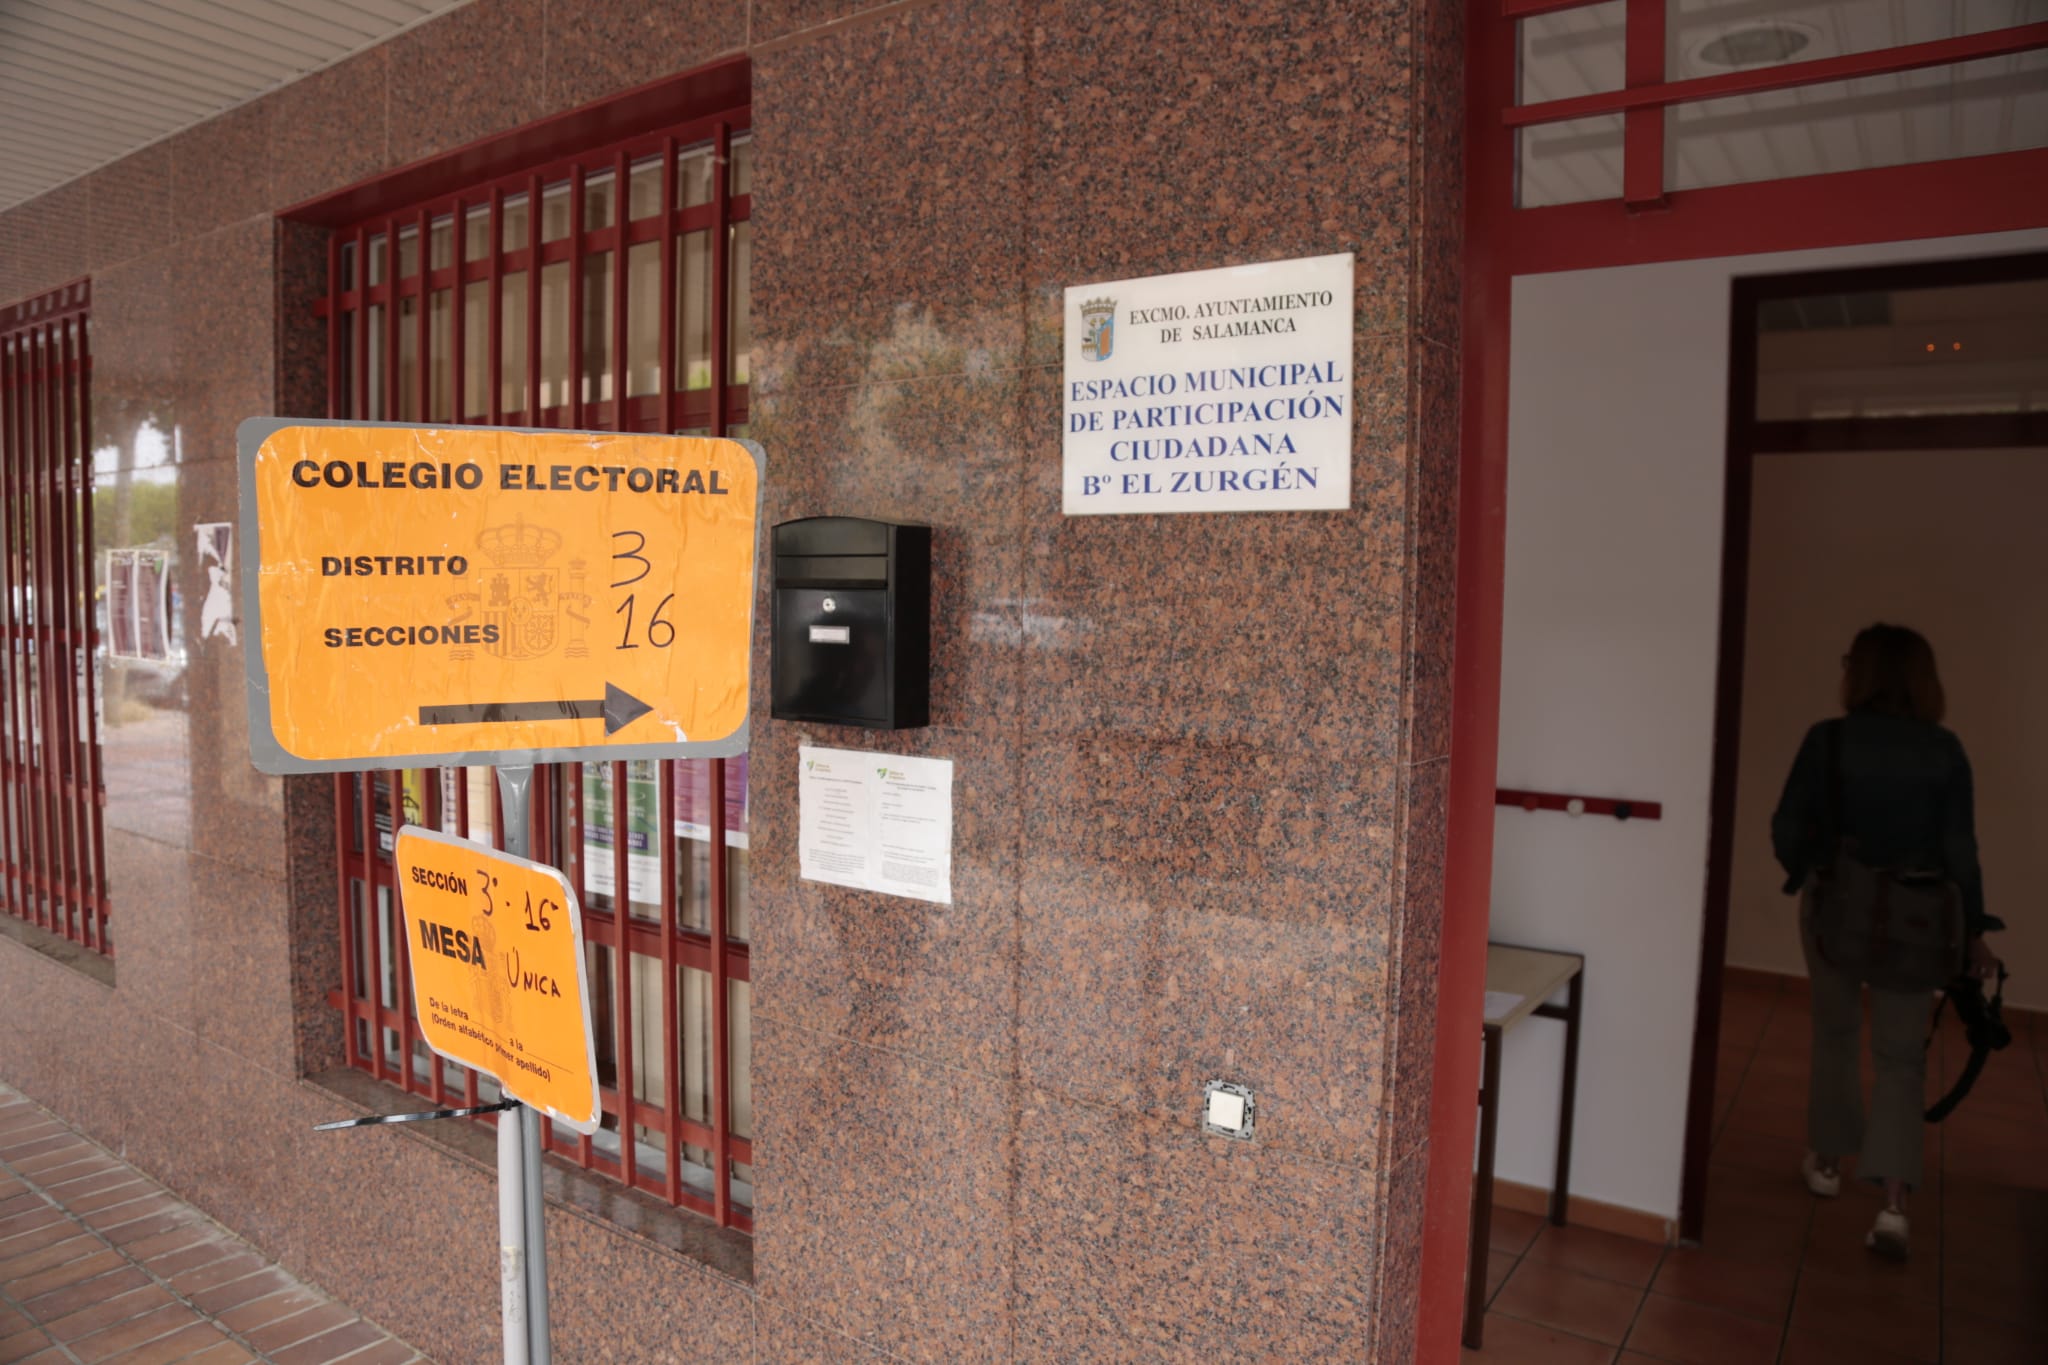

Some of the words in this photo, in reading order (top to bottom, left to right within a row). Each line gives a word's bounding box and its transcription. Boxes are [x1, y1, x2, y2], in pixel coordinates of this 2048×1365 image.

[1129, 304, 1190, 325] EXCMO.
[1194, 290, 1333, 319] AYUNTAMIENTO
[1160, 328, 1182, 344] DE
[1192, 317, 1297, 341] SALAMANCA
[1071, 373, 1177, 402] ESPACIO
[1184, 361, 1344, 393] MUNICIPAL
[1070, 411, 1104, 433] DE
[1112, 390, 1344, 430] PARTICIPACIÓN
[1110, 433, 1297, 462] CIUDADANA
[291, 460, 484, 490] COLEGIO
[499, 464, 729, 495] ELECTORAL
[1122, 473, 1162, 495] EL
[1170, 461, 1319, 494] ZURGÉN
[321, 555, 468, 577] DISTRITO
[610, 530, 652, 588] 3
[323, 624, 500, 647] SECCIONES
[615, 593, 676, 650] 16
[411, 866, 468, 896] SECCIÓN
[418, 919, 487, 971] MESA
[429, 997, 440, 1010] De
[441, 1000, 449, 1013] la
[450, 1003, 469, 1021] letra
[515, 1039, 523, 1052] la
[431, 1012, 457, 1031] (Orden
[458, 1024, 494, 1048] alfabético
[515, 1057, 551, 1083] apellido)
